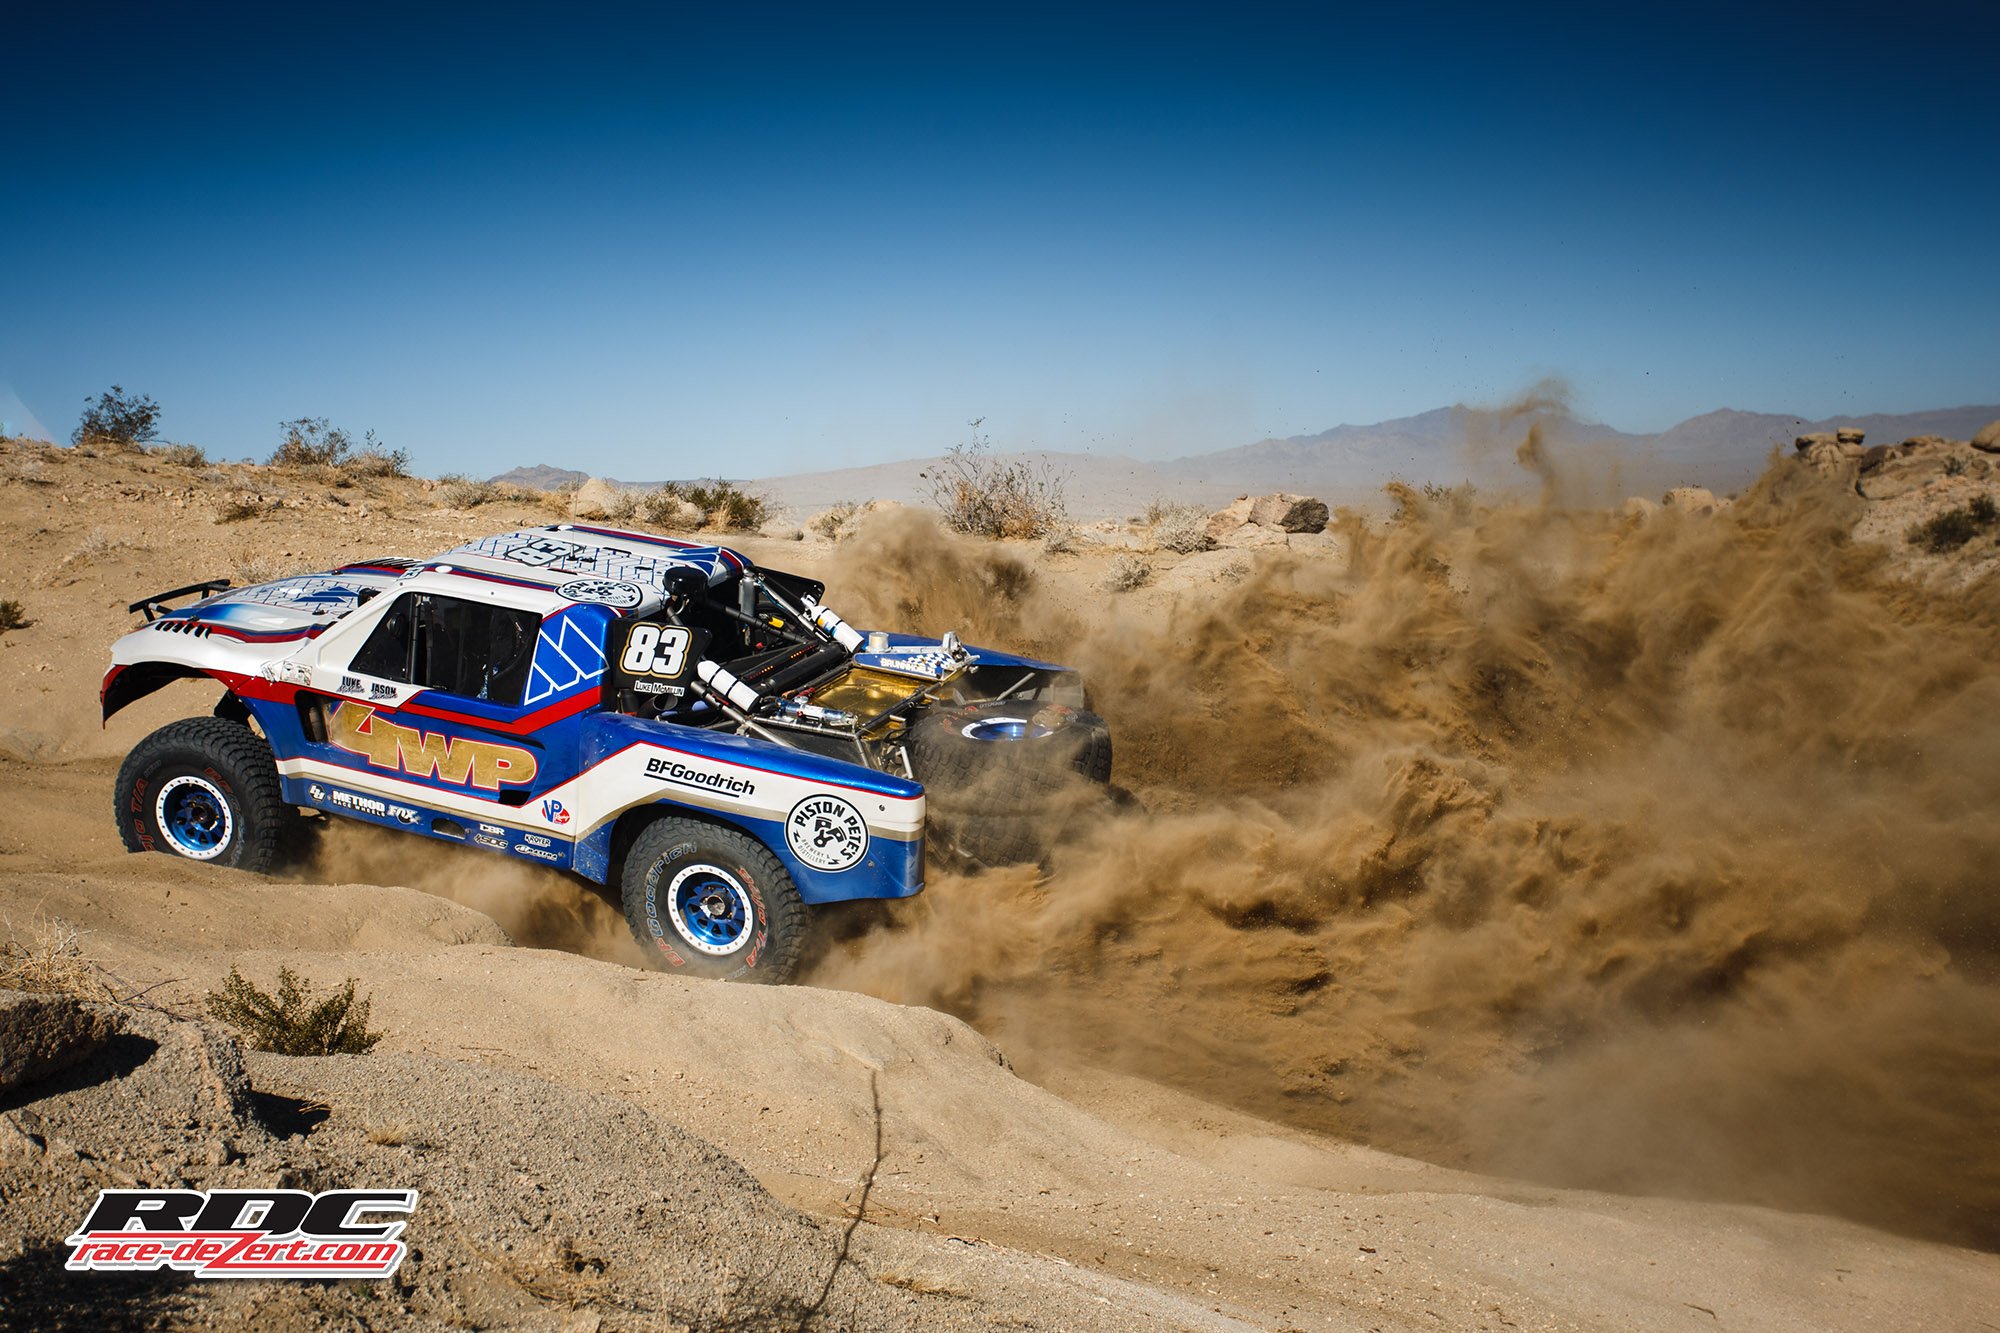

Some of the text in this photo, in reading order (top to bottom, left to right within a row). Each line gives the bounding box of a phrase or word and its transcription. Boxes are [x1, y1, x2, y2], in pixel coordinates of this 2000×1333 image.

[621, 623, 691, 678] 83
[341, 675, 362, 689] LUKE
[371, 682, 397, 695] JASON
[329, 700, 538, 791] 4WP
[646, 757, 756, 795] BFGoodrich
[332, 789, 386, 812] METHOD
[543, 799, 563, 823] VP
[386, 803, 420, 825] FOX
[794, 801, 862, 861] PISTON PETE'S
